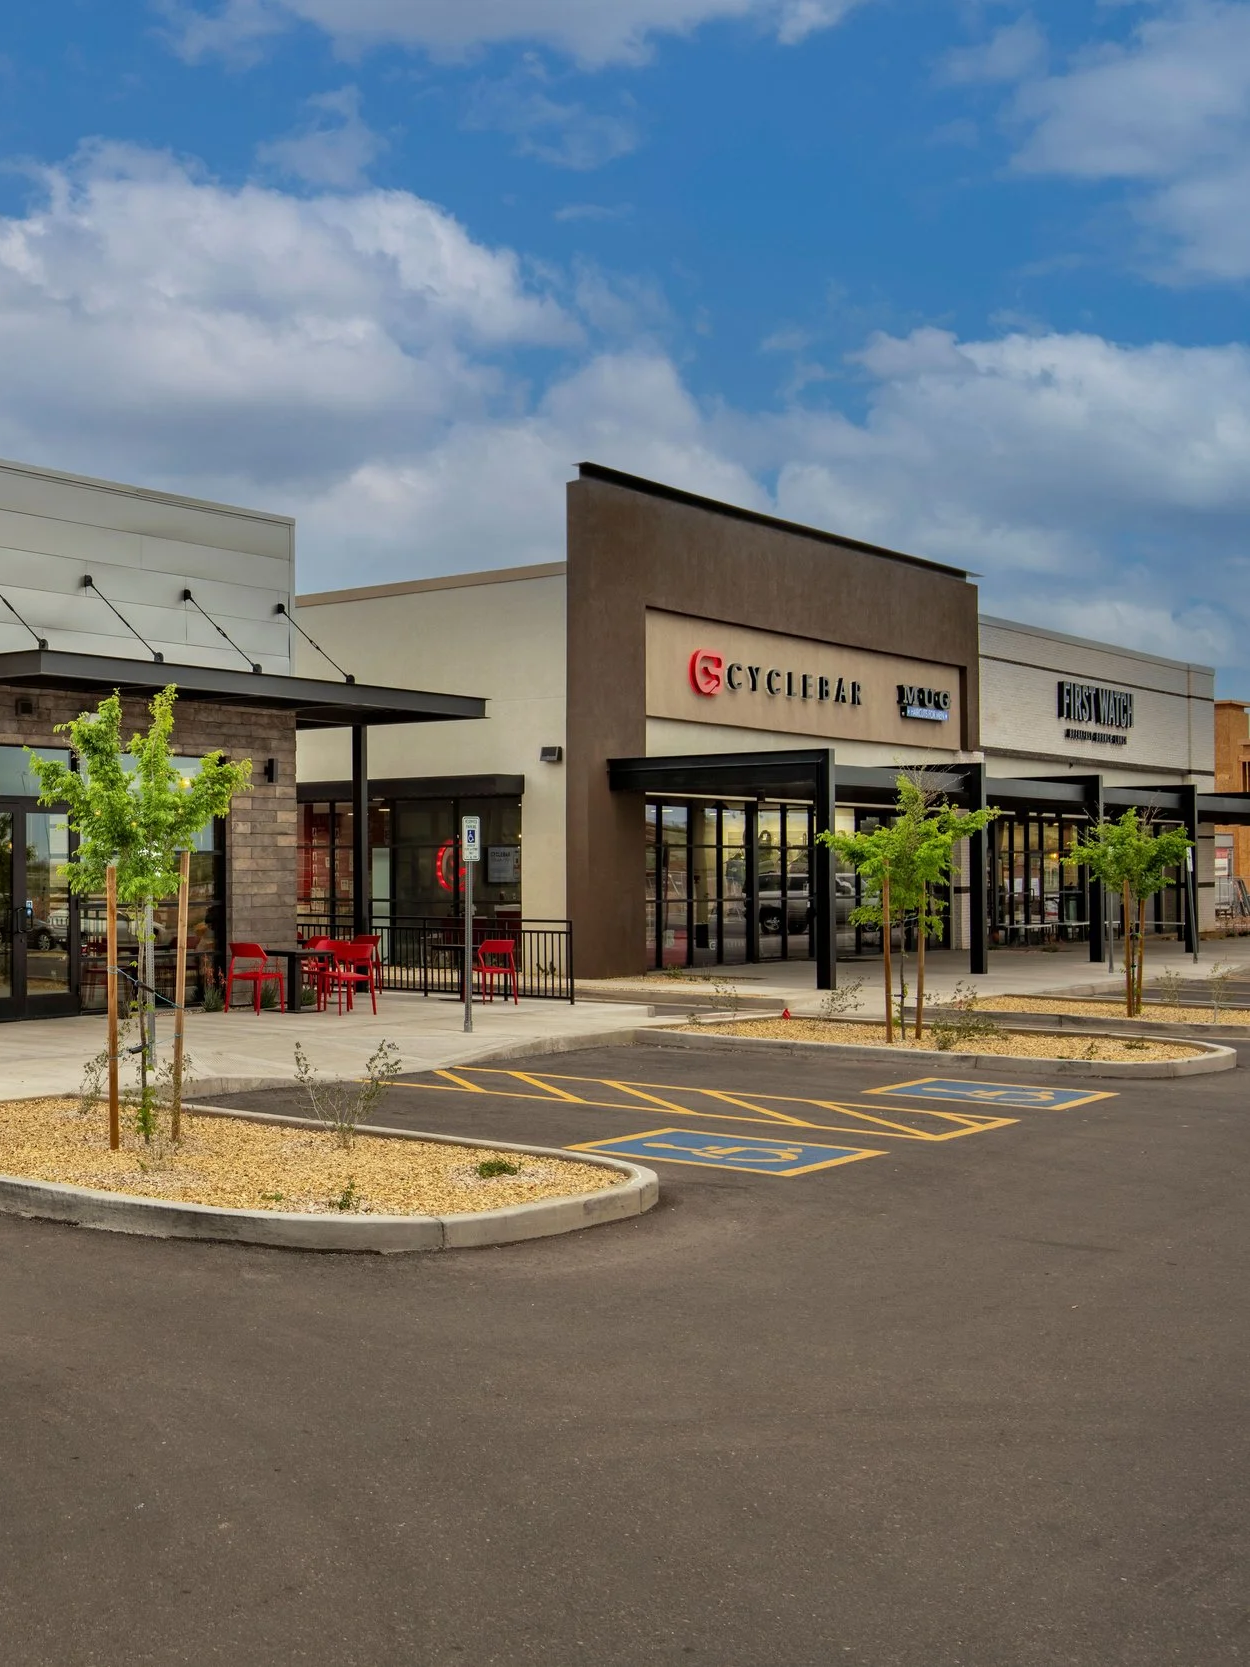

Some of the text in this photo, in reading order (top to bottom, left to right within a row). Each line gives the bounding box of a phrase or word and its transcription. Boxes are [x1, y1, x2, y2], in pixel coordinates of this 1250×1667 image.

[726, 662, 863, 706] CYCLEBAR
[1059, 681, 1134, 729] FIRST WATCH
